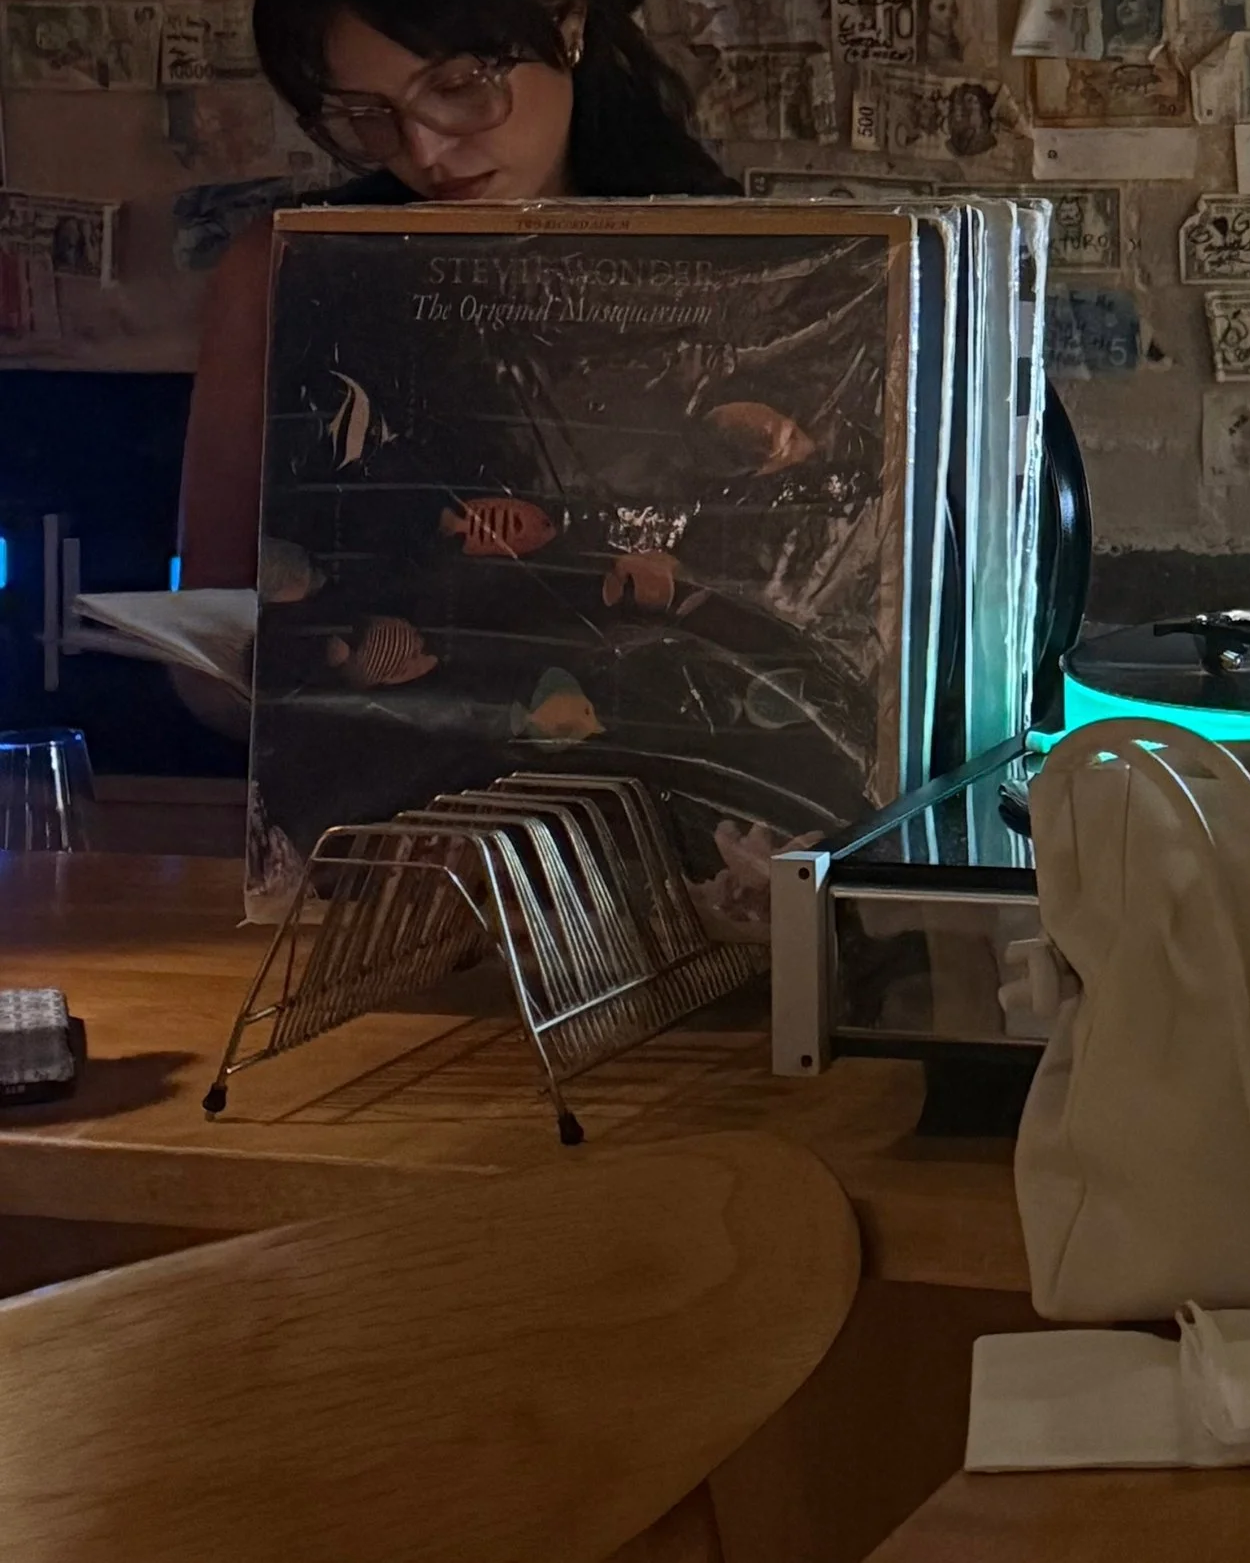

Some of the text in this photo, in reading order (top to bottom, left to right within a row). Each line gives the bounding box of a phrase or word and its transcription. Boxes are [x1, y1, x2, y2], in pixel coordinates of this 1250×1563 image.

[857, 106, 874, 137] 500
[412, 291, 713, 334] The Original Musiquarium
[1109, 339, 1127, 366] 5
